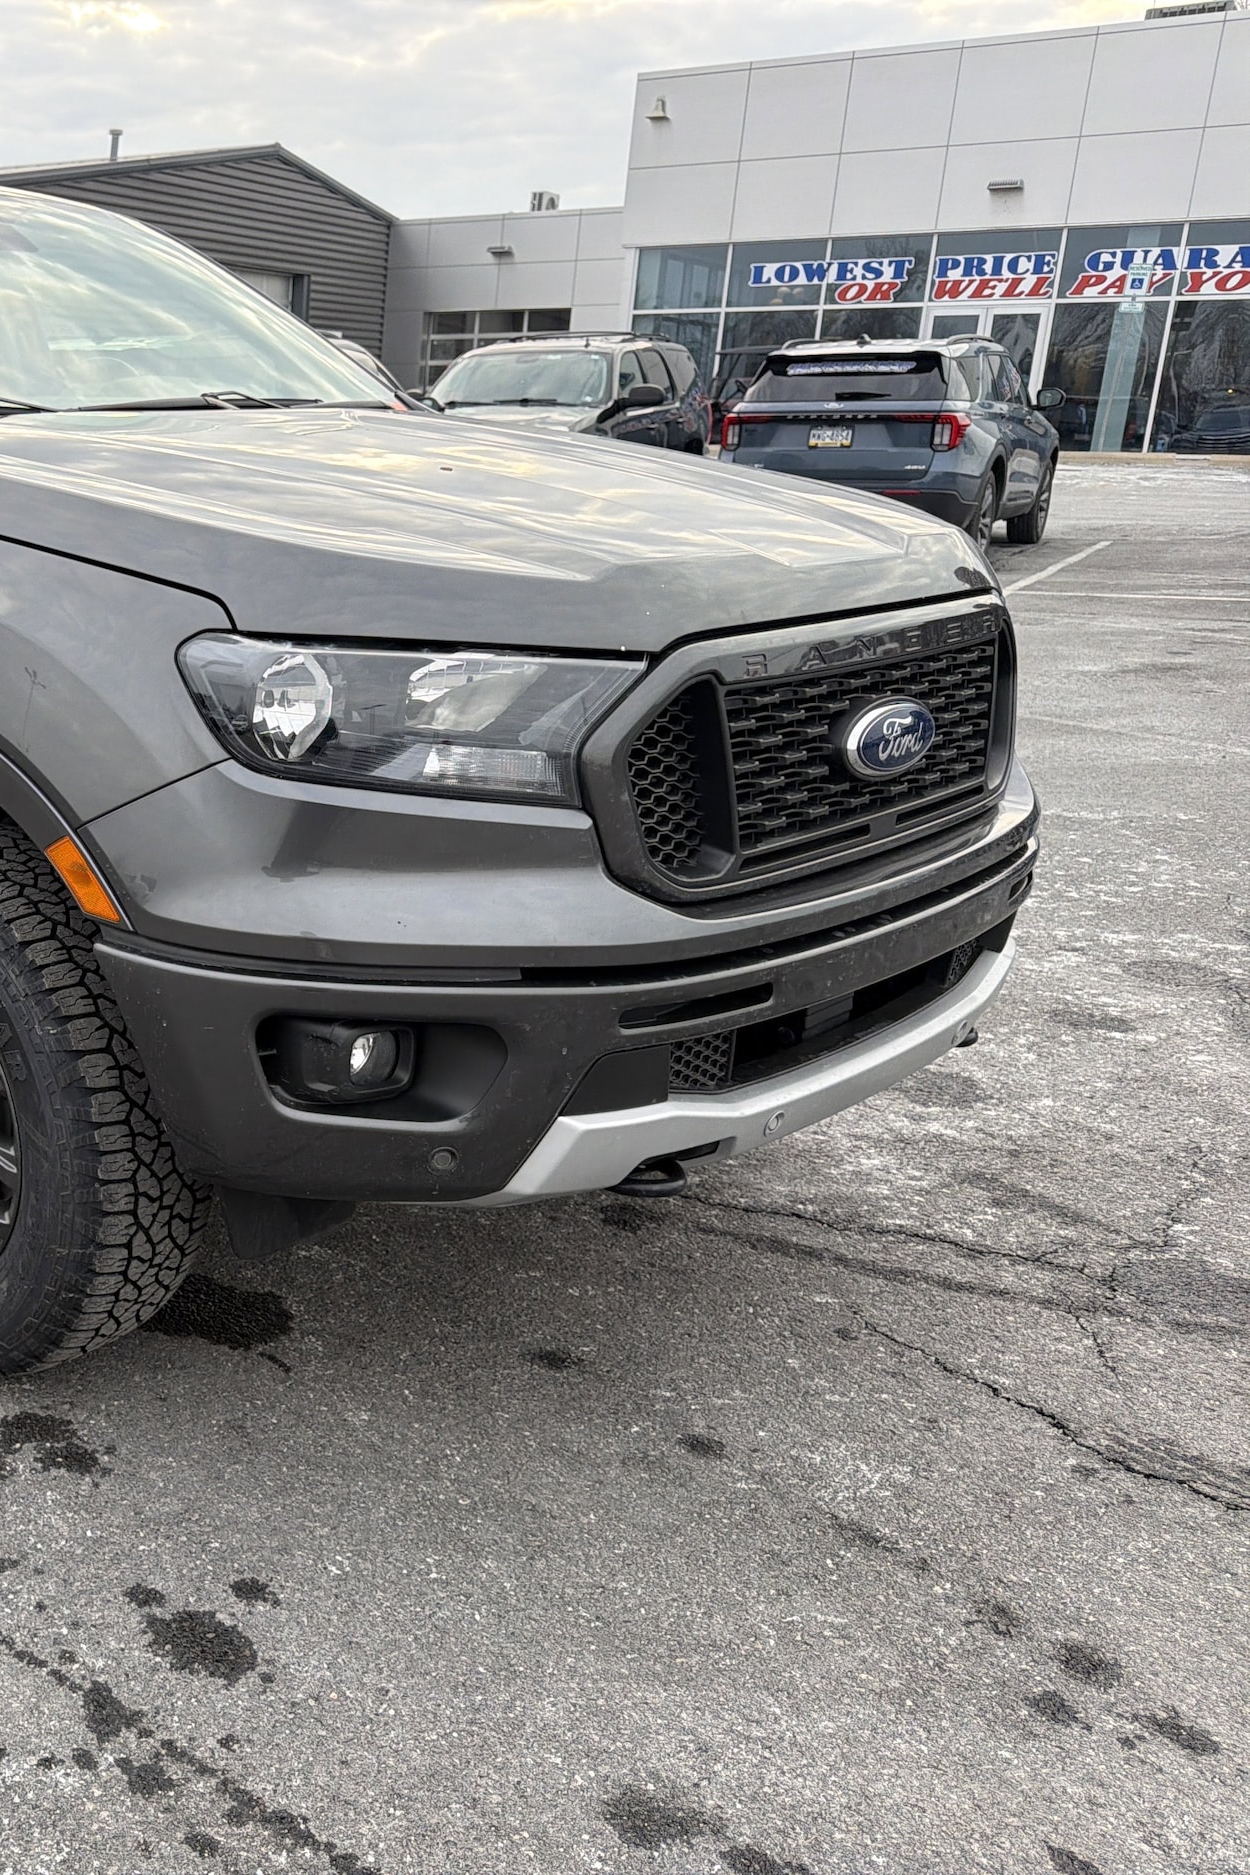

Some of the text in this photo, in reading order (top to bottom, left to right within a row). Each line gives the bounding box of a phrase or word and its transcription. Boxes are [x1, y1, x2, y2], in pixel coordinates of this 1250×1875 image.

[751, 258, 913, 285] LOWEST
[935, 252, 1057, 279] PRICE
[837, 281, 901, 302] OR
[934, 275, 1053, 300] WE'LL
[1068, 271, 1173, 296] PAY
[741, 614, 996, 678] RANGER
[878, 714, 924, 762] Ford
